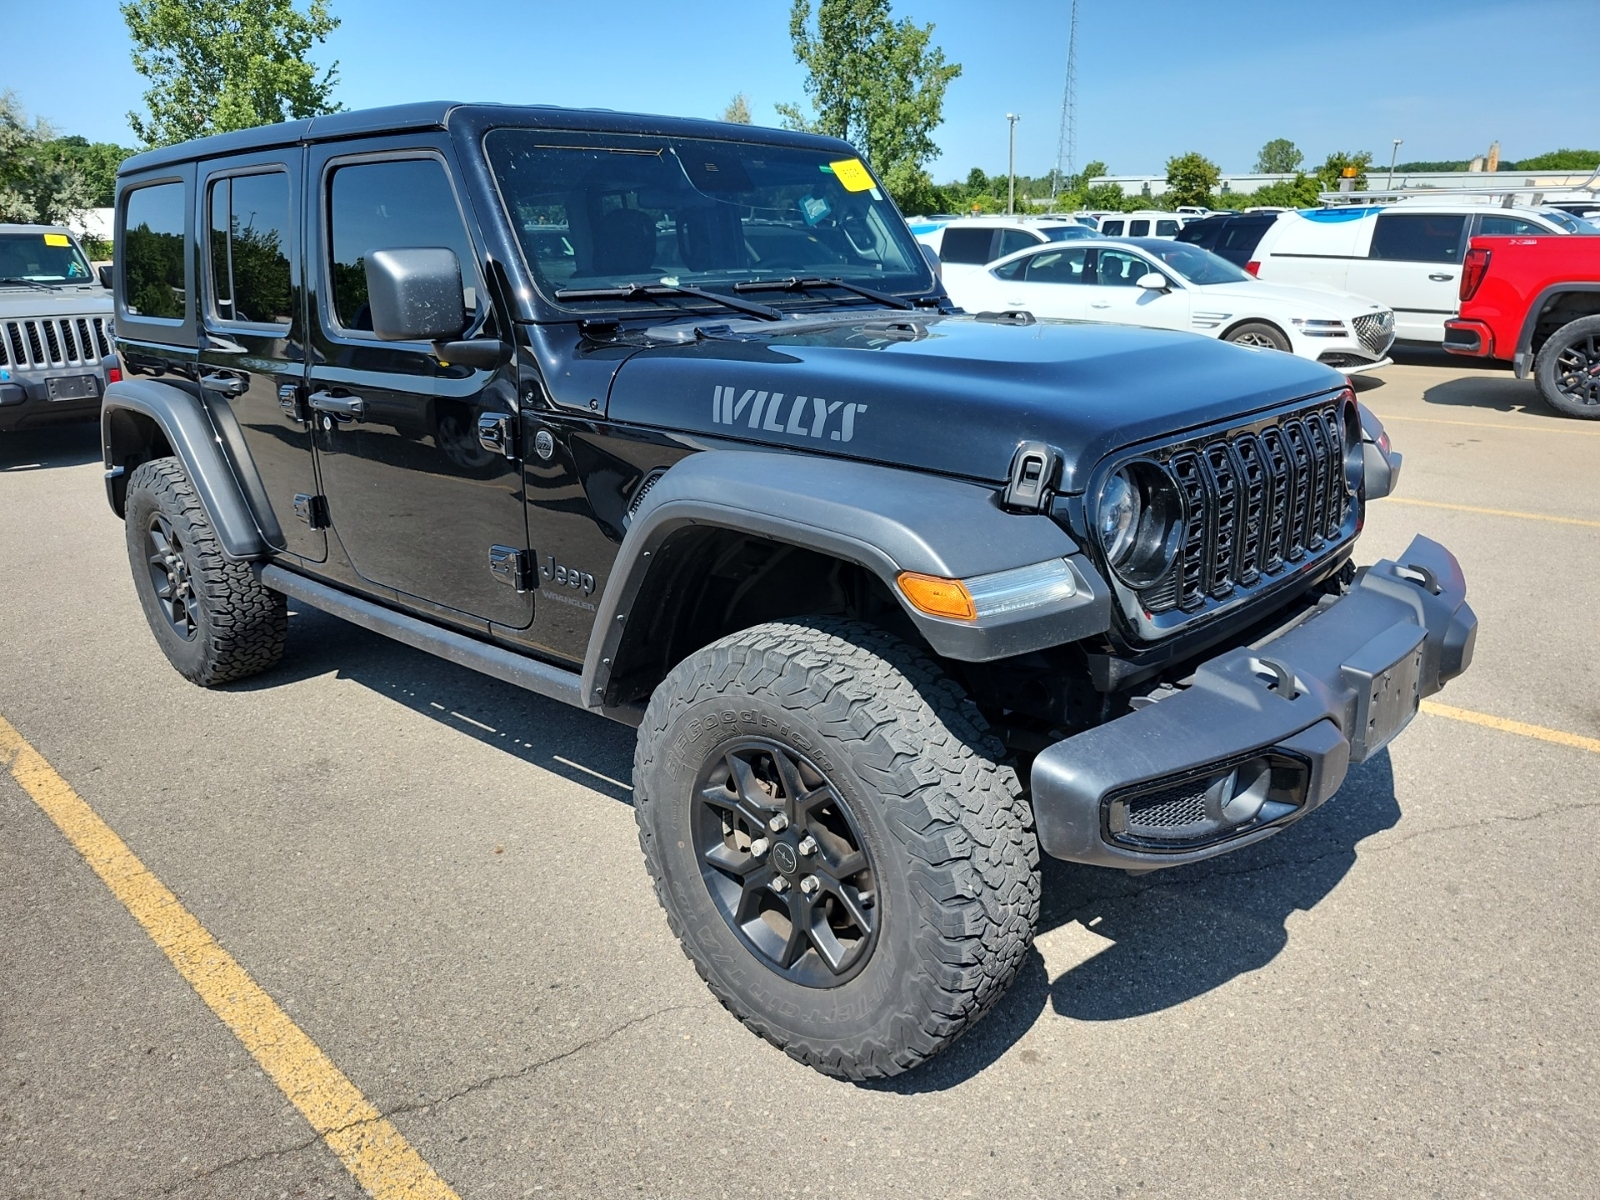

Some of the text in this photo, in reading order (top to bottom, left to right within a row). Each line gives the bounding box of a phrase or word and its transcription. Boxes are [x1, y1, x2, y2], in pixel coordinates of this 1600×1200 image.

[713, 385, 868, 442] WILLYS
[540, 555, 596, 597] Jeep
[541, 588, 596, 612] WRANGLER
[663, 709, 834, 781] BFGoodrich
